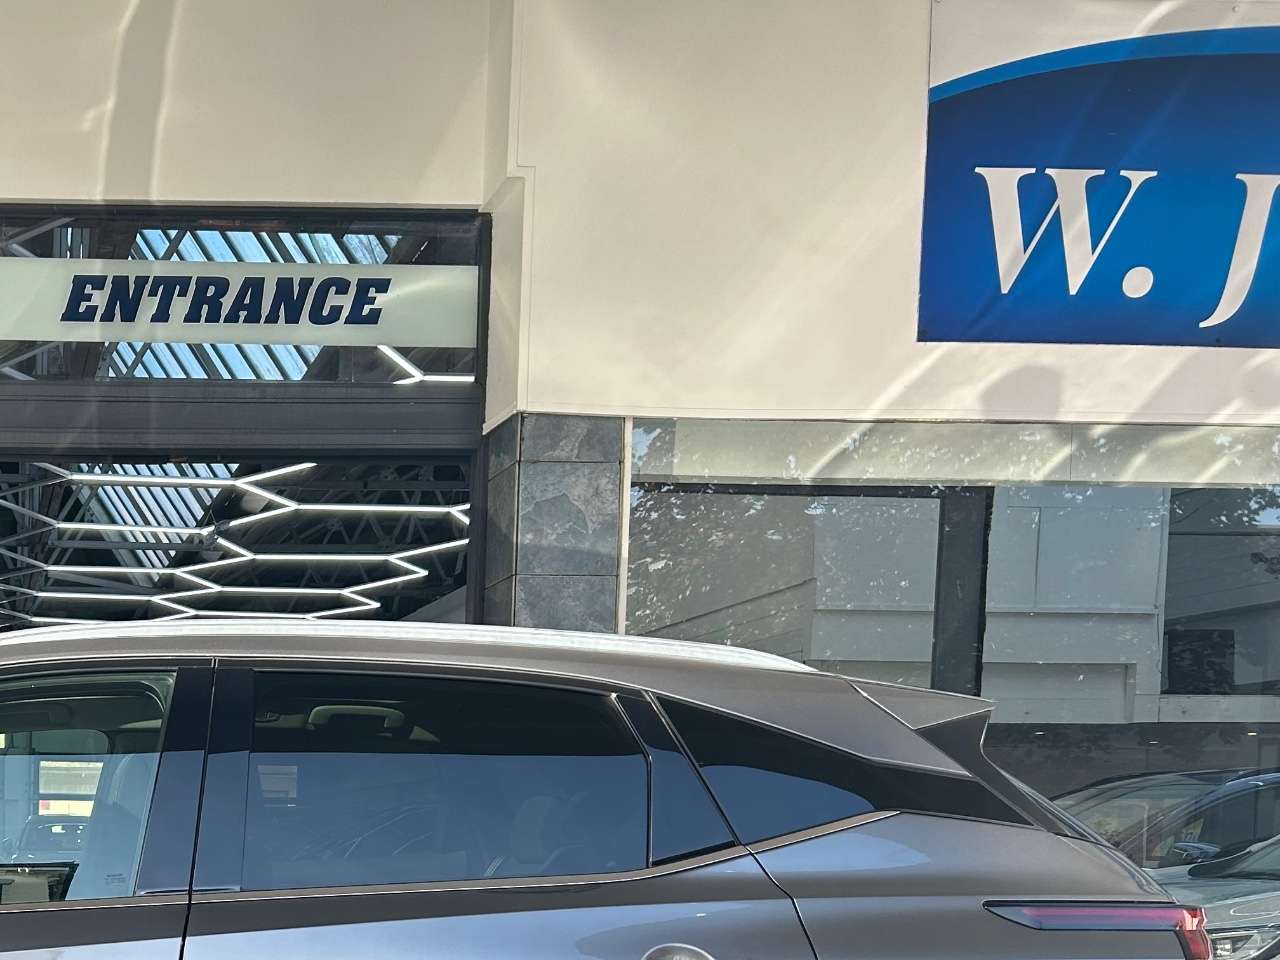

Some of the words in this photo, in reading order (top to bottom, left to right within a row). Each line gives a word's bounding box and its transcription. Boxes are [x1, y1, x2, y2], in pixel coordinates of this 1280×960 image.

[59, 274, 393, 326] ENTRANCE
[975, 167, 1158, 299] W.
[1199, 173, 1280, 329] J
